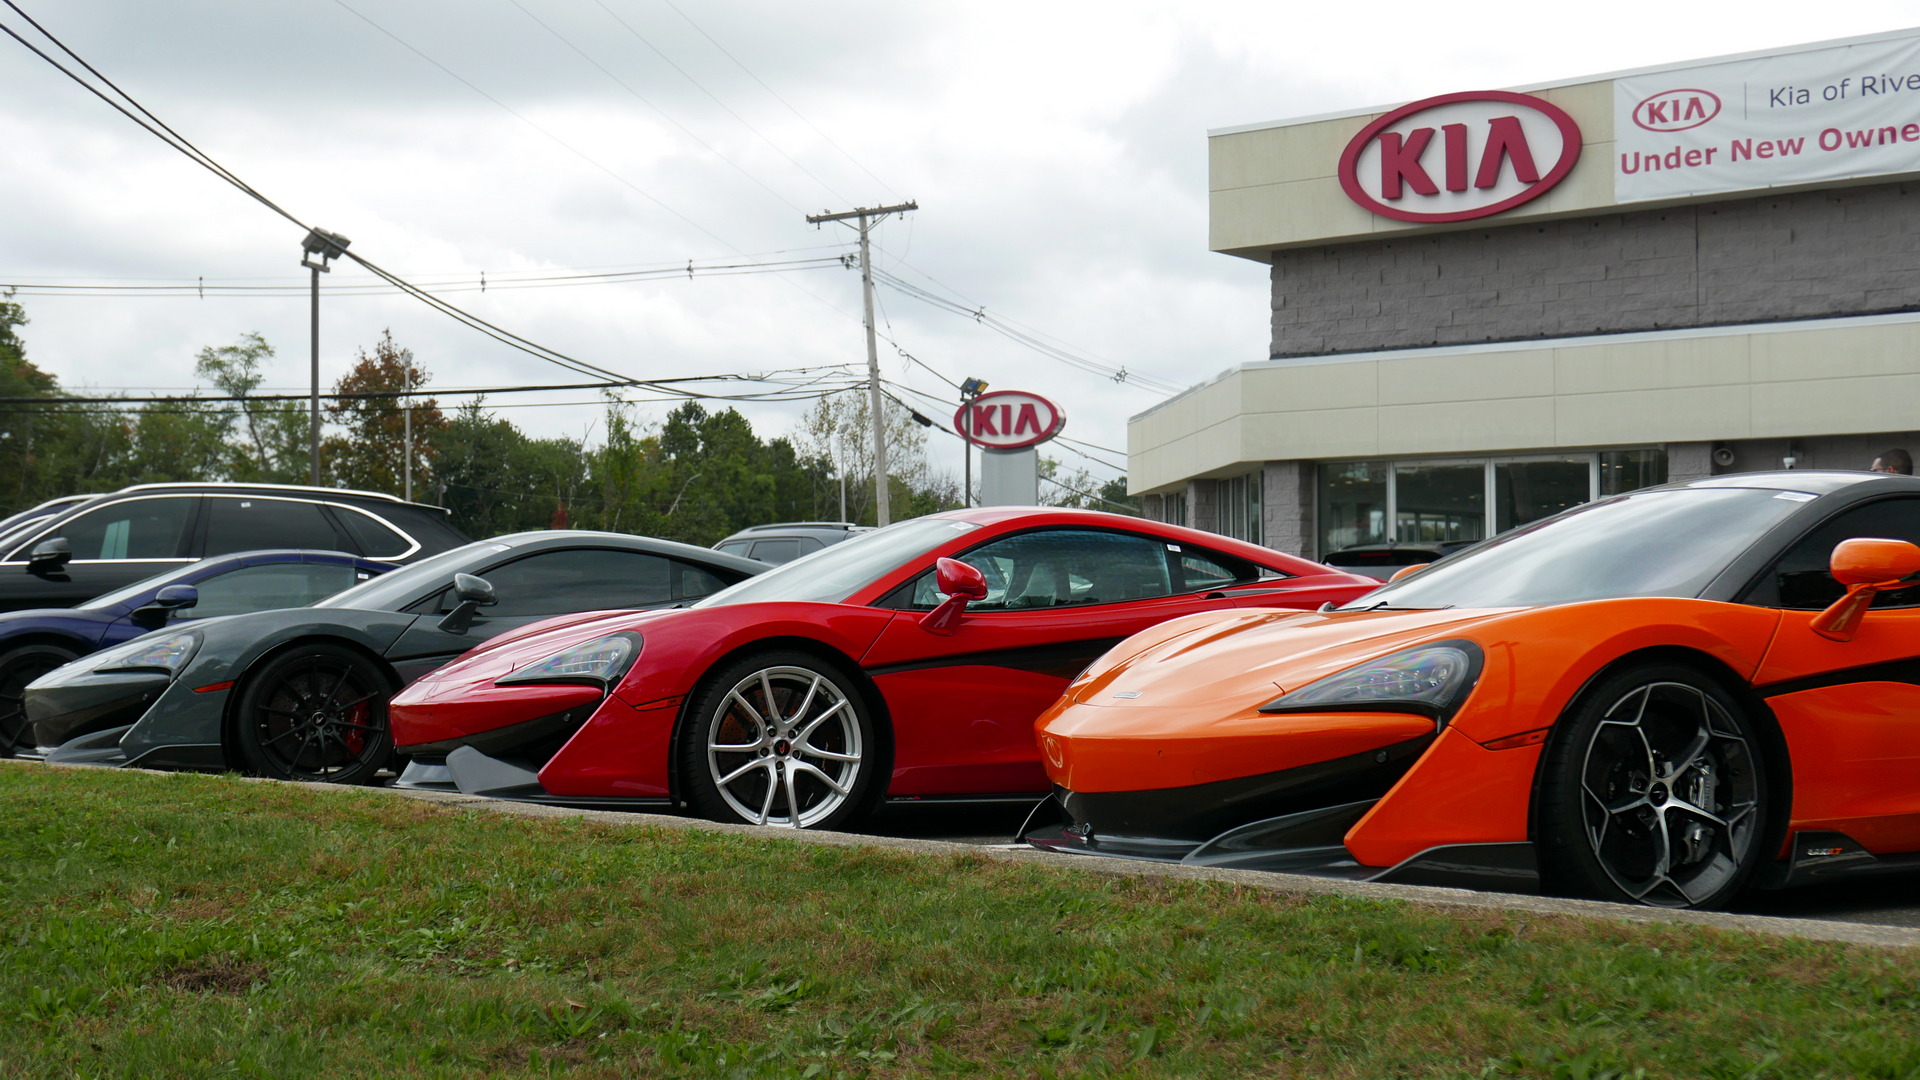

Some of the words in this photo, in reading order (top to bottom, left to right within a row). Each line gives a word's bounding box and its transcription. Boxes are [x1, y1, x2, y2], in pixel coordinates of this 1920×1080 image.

[1770, 87, 1810, 108] Kia
[1823, 78, 1850, 101] of
[1861, 74, 1920, 96] Rive
[1647, 97, 1706, 125] KIA
[1377, 116, 1540, 200] KIA
[1621, 146, 1718, 175] Under
[1731, 138, 1805, 162] New
[1818, 122, 1920, 152] Owne
[973, 403, 1042, 436] KIA
